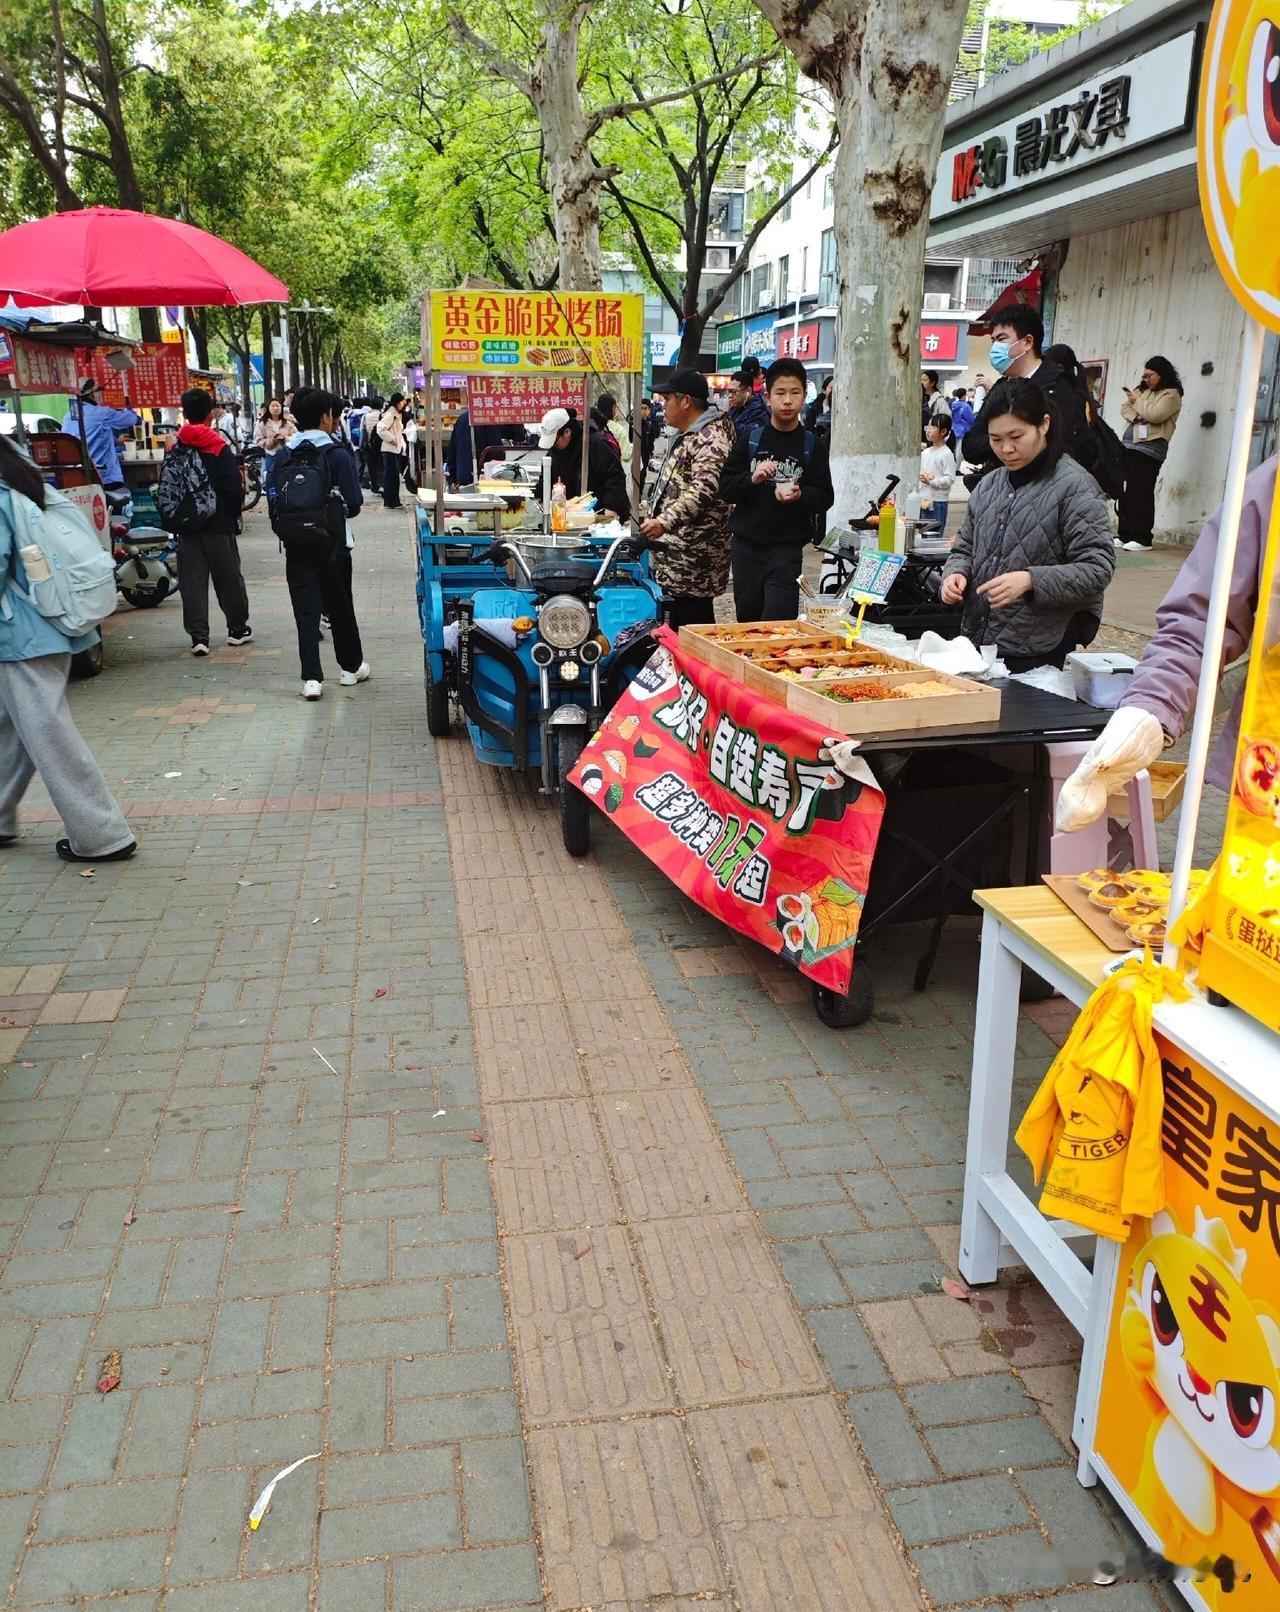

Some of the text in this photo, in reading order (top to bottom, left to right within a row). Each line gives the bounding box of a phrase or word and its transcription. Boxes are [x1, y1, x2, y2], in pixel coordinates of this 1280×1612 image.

[1012, 75, 1132, 177] 晨光文具
[442, 295, 623, 337] 黄金脆皮烤肠
[924, 333, 940, 352] 市
[471, 376, 584, 395] 山东杂粮煎饼
[472, 395, 584, 409] 鸡蛋+生菜+小米饼=6元
[634, 772, 770, 904] 超多种类1元起
[1070, 1132, 1128, 1157] TIGER
